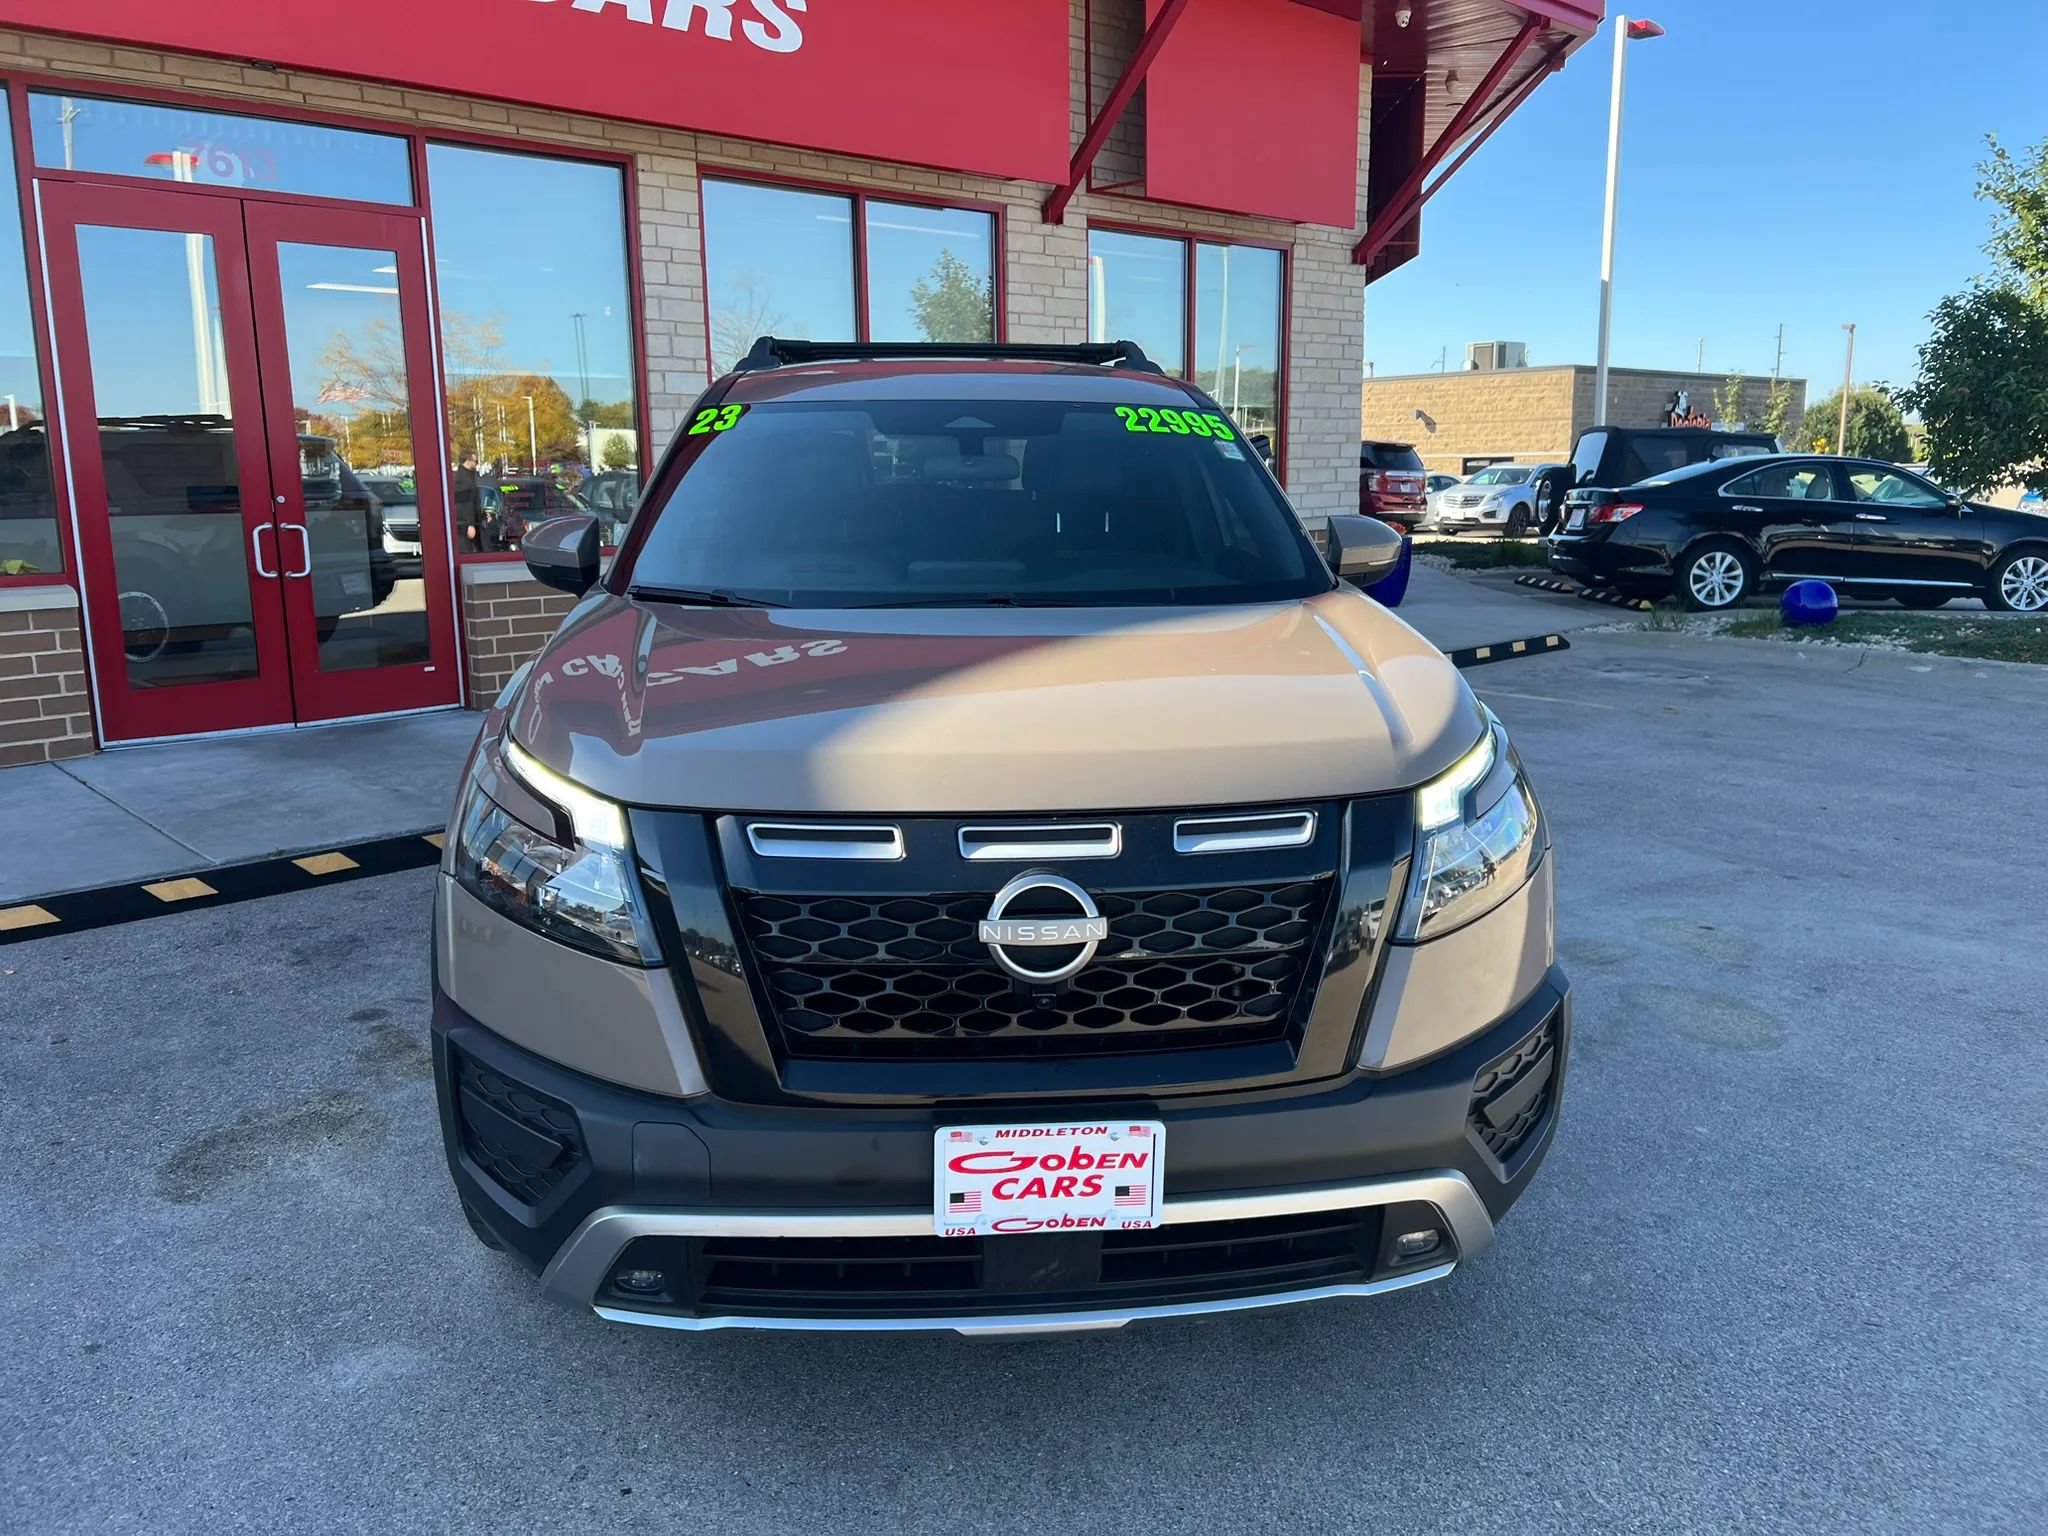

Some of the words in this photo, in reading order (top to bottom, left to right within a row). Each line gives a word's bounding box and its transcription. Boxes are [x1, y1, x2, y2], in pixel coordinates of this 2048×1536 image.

[528, 0, 806, 53] RS
[688, 404, 743, 436] 23
[1114, 406, 1235, 441] 22995
[983, 923, 1103, 941] NISSAN
[995, 1126, 1108, 1138] MIDDLETON
[991, 1174, 1105, 1200] CARS
[944, 1227, 977, 1237] USA
[1121, 1220, 1152, 1230] USA
